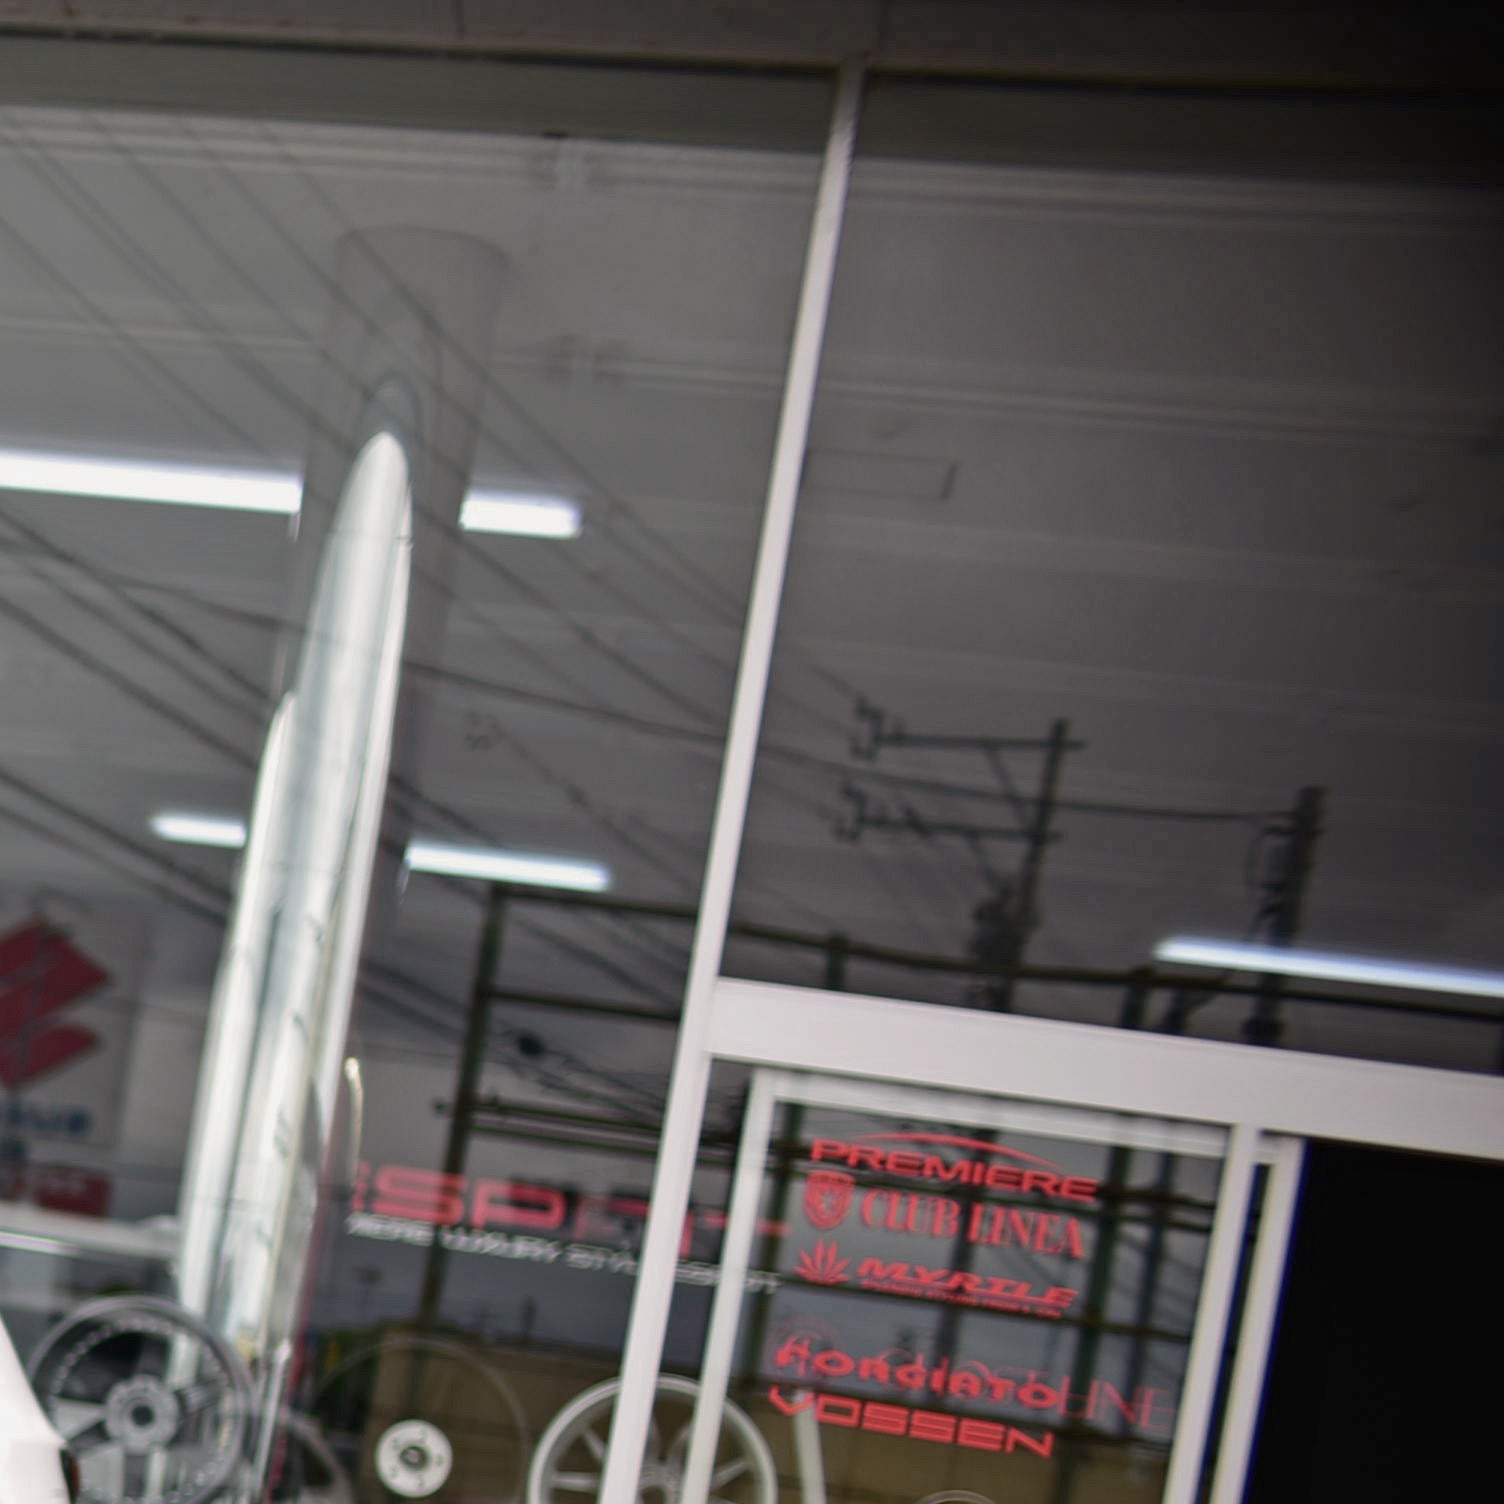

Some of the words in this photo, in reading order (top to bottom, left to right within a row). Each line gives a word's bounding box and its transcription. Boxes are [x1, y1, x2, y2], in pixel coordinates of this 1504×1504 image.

[809, 1138, 1099, 1201] PREMIERE
[860, 1187, 959, 1241] CLUB
[966, 1202, 1086, 1259] LINEA
[768, 1385, 1055, 1458] VOSSEN
